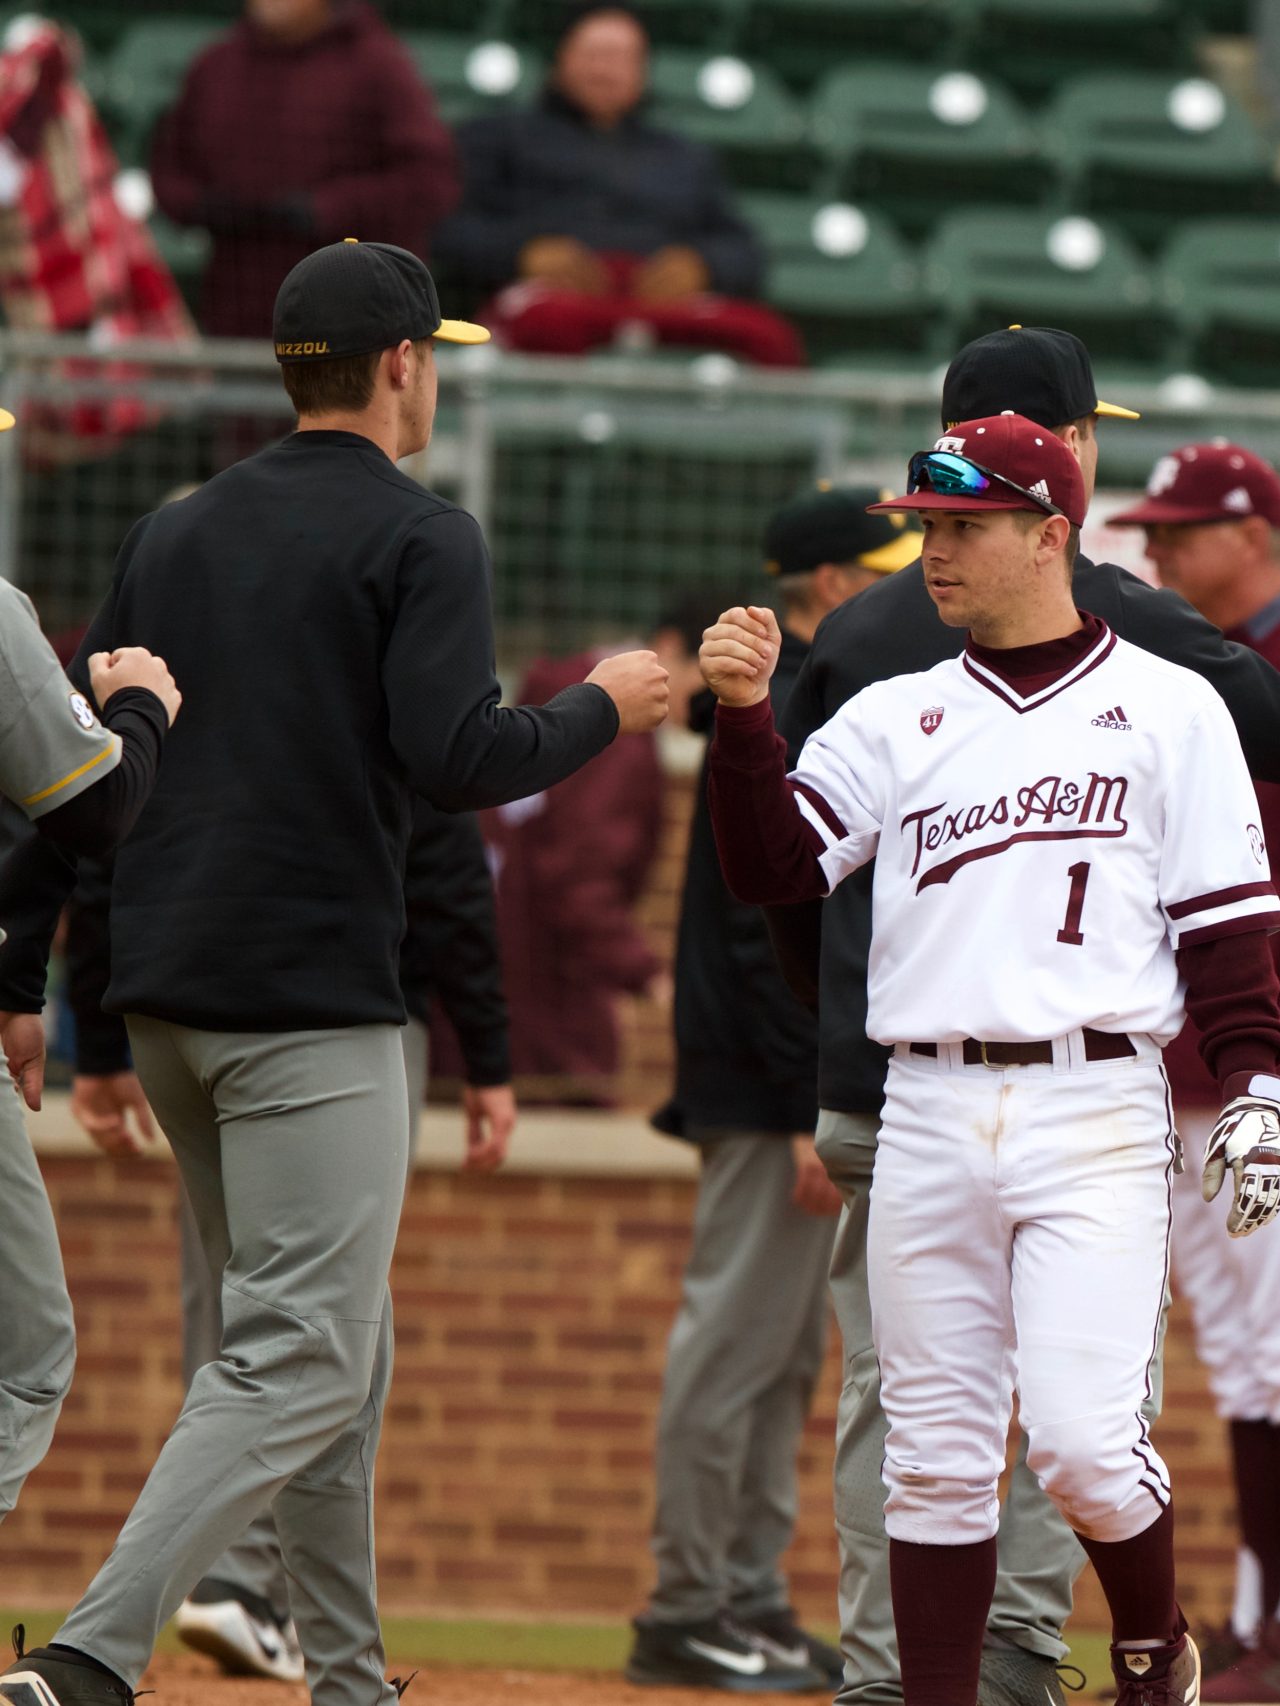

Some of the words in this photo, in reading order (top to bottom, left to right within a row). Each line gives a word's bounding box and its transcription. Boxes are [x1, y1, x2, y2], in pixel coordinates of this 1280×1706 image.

[922, 714, 938, 729] 41
[1089, 717, 1133, 731] adidas
[901, 795, 1009, 879] Texas
[1014, 772, 1129, 828] A&M
[1057, 861, 1090, 946] 1
